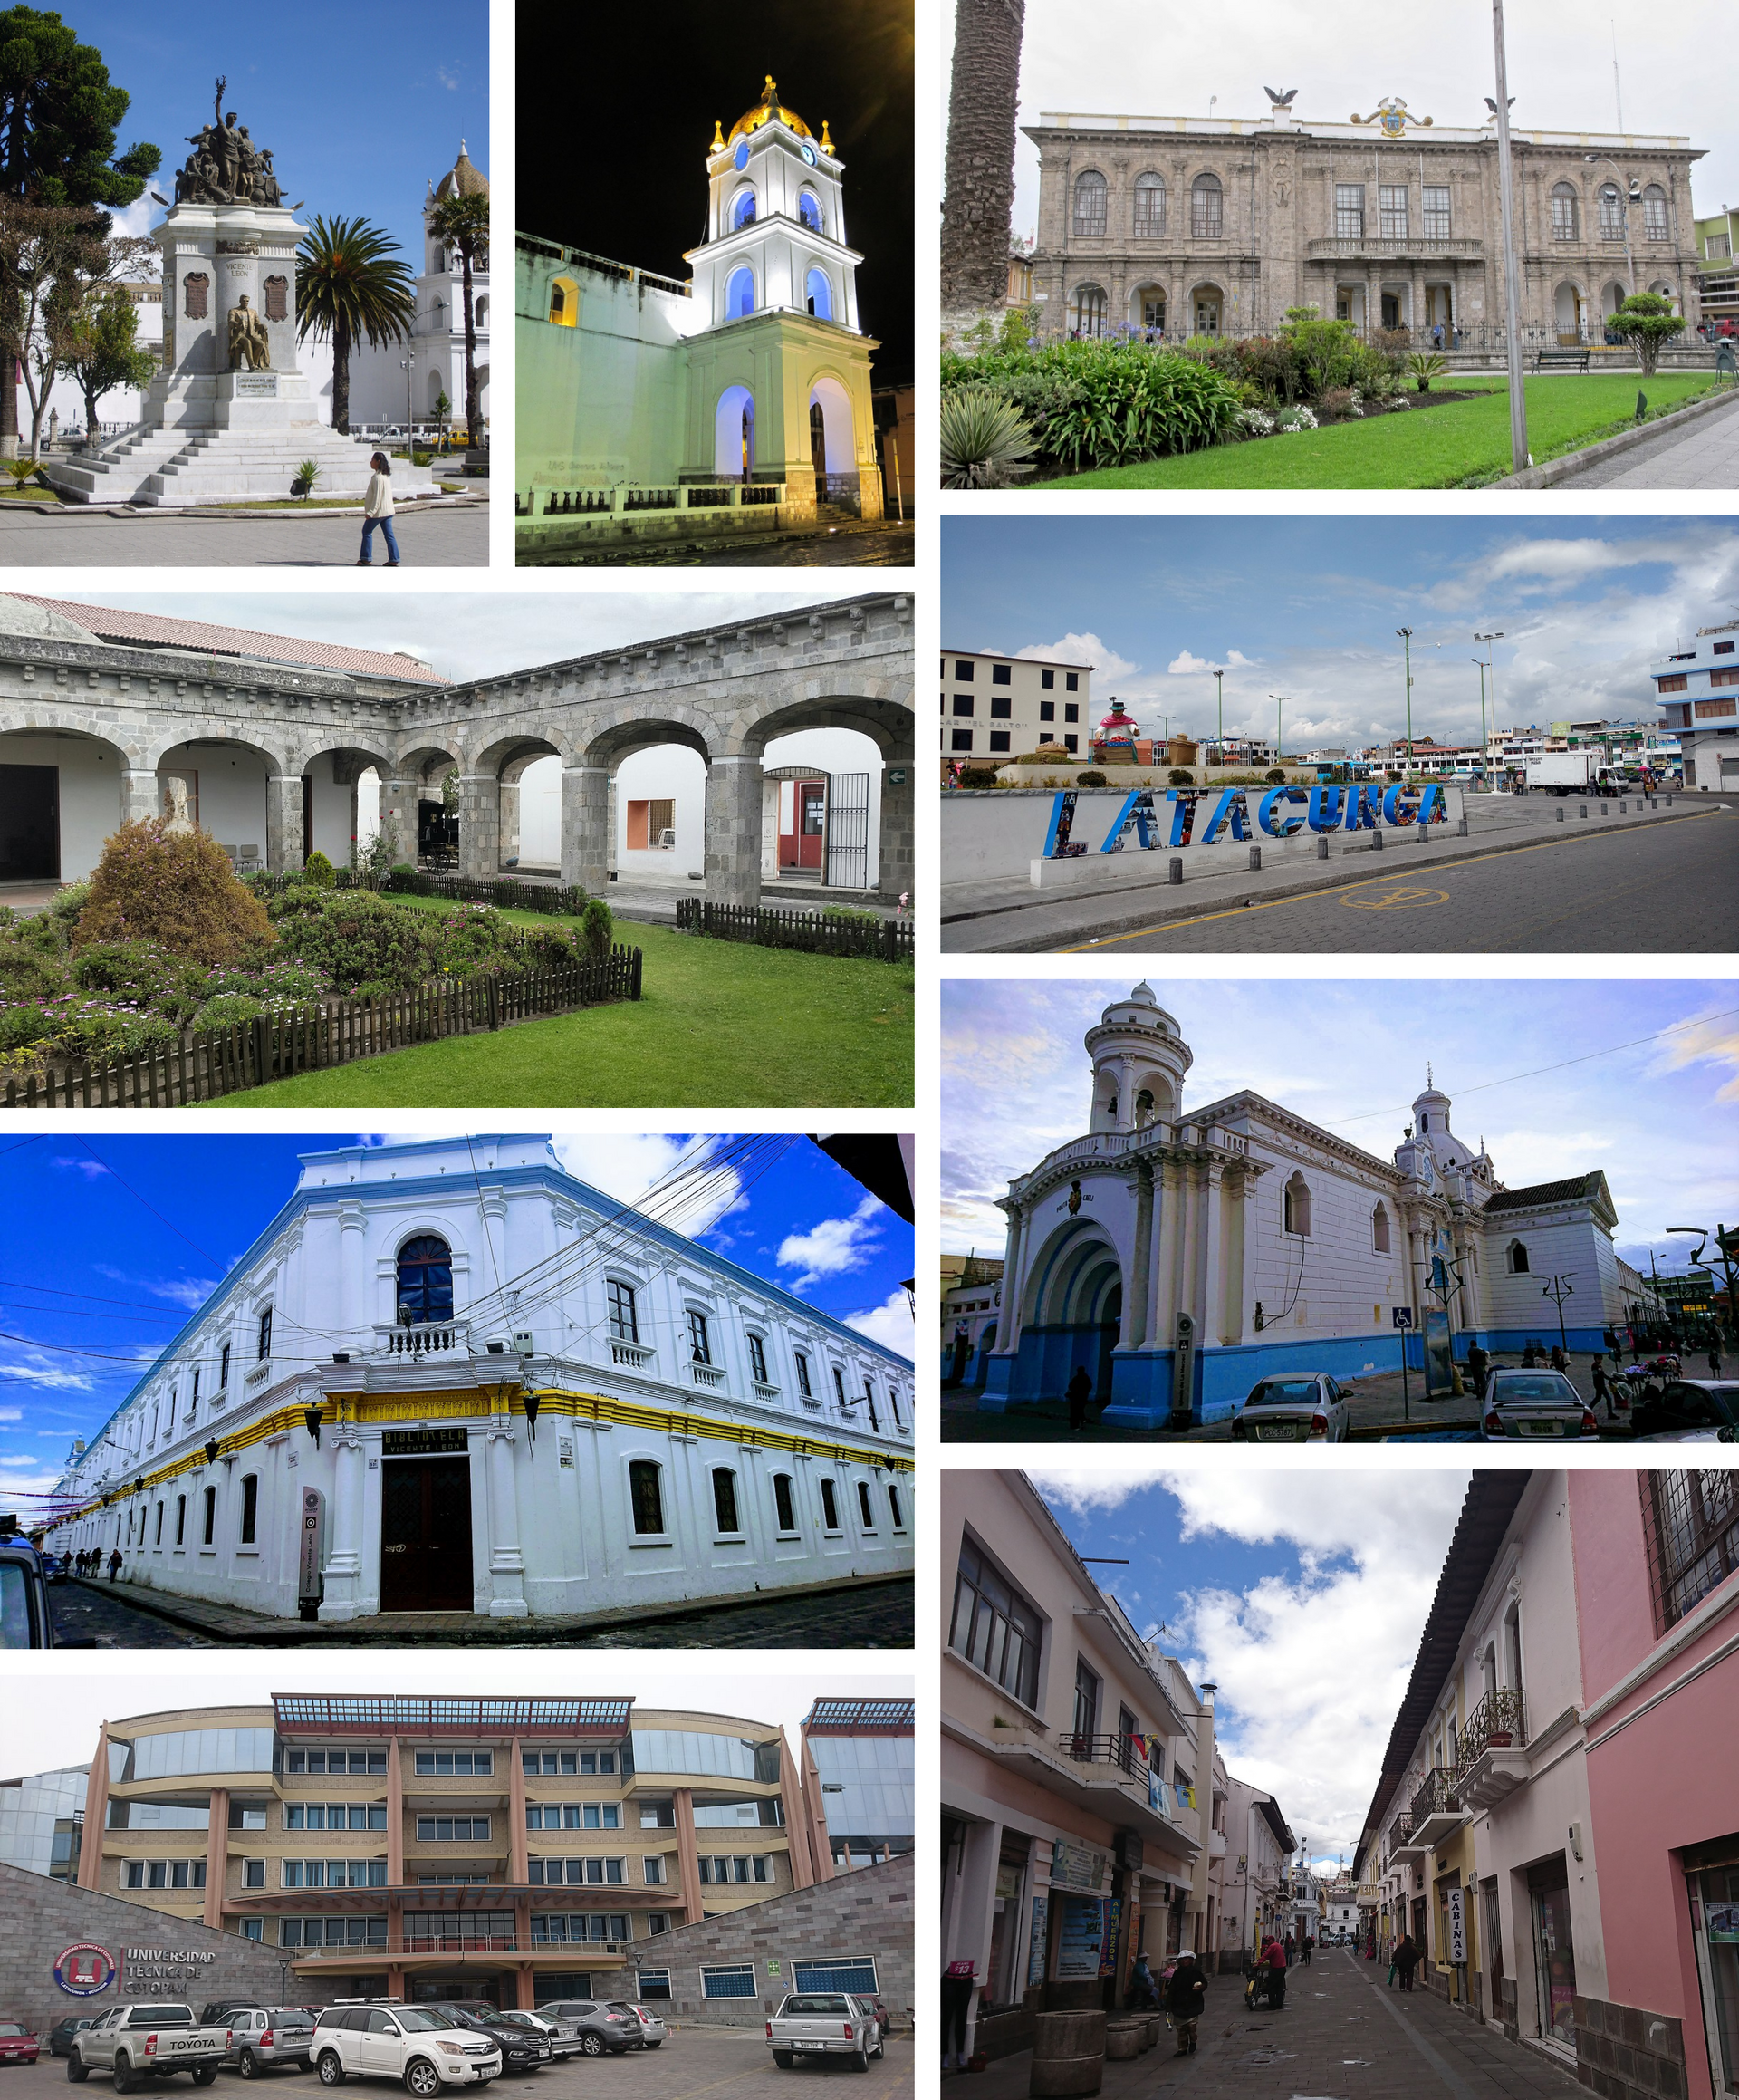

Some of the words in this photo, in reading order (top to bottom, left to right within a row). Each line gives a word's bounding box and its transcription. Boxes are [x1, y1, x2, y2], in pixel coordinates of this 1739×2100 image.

[1042, 783, 1449, 858] LATACUNGA
[1109, 1901, 1119, 1960] ALMUERZOS
[1451, 1893, 1462, 1958] CABINAS
[127, 1948, 216, 1964] UNIVERSIDAD
[126, 1964, 181, 1979] TÉCNICA
[186, 1966, 202, 1979] DE
[954, 1965, 969, 1974] $13
[123, 1981, 188, 1995] COTOPAXI
[170, 2038, 216, 2051] TOYOTA
